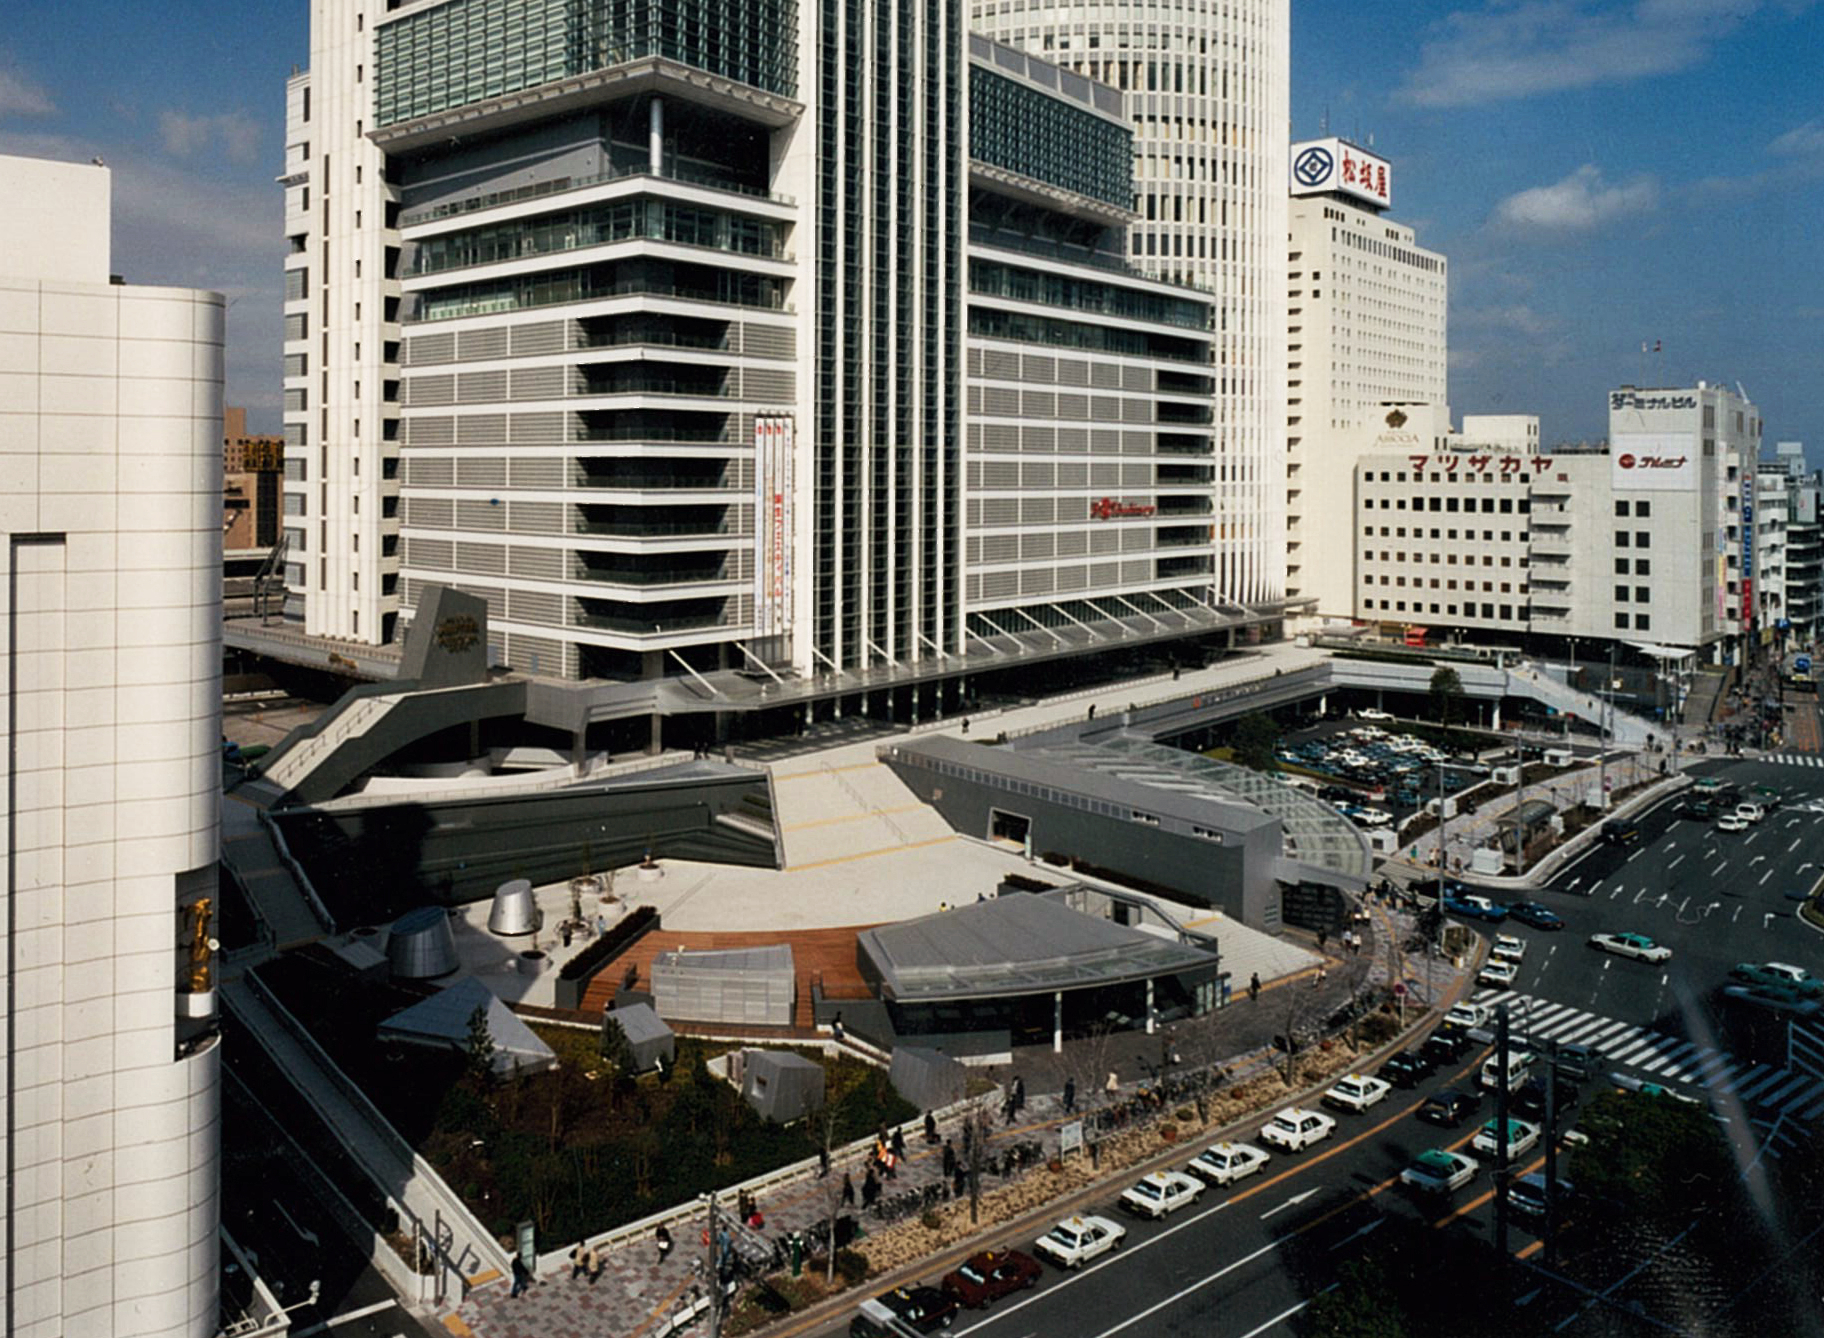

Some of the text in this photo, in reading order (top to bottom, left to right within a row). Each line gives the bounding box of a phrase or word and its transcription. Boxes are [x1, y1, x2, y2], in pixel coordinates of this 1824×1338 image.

[1342, 148, 1387, 198] 松坂屋
[1408, 454, 1553, 474] マツザカヤ
